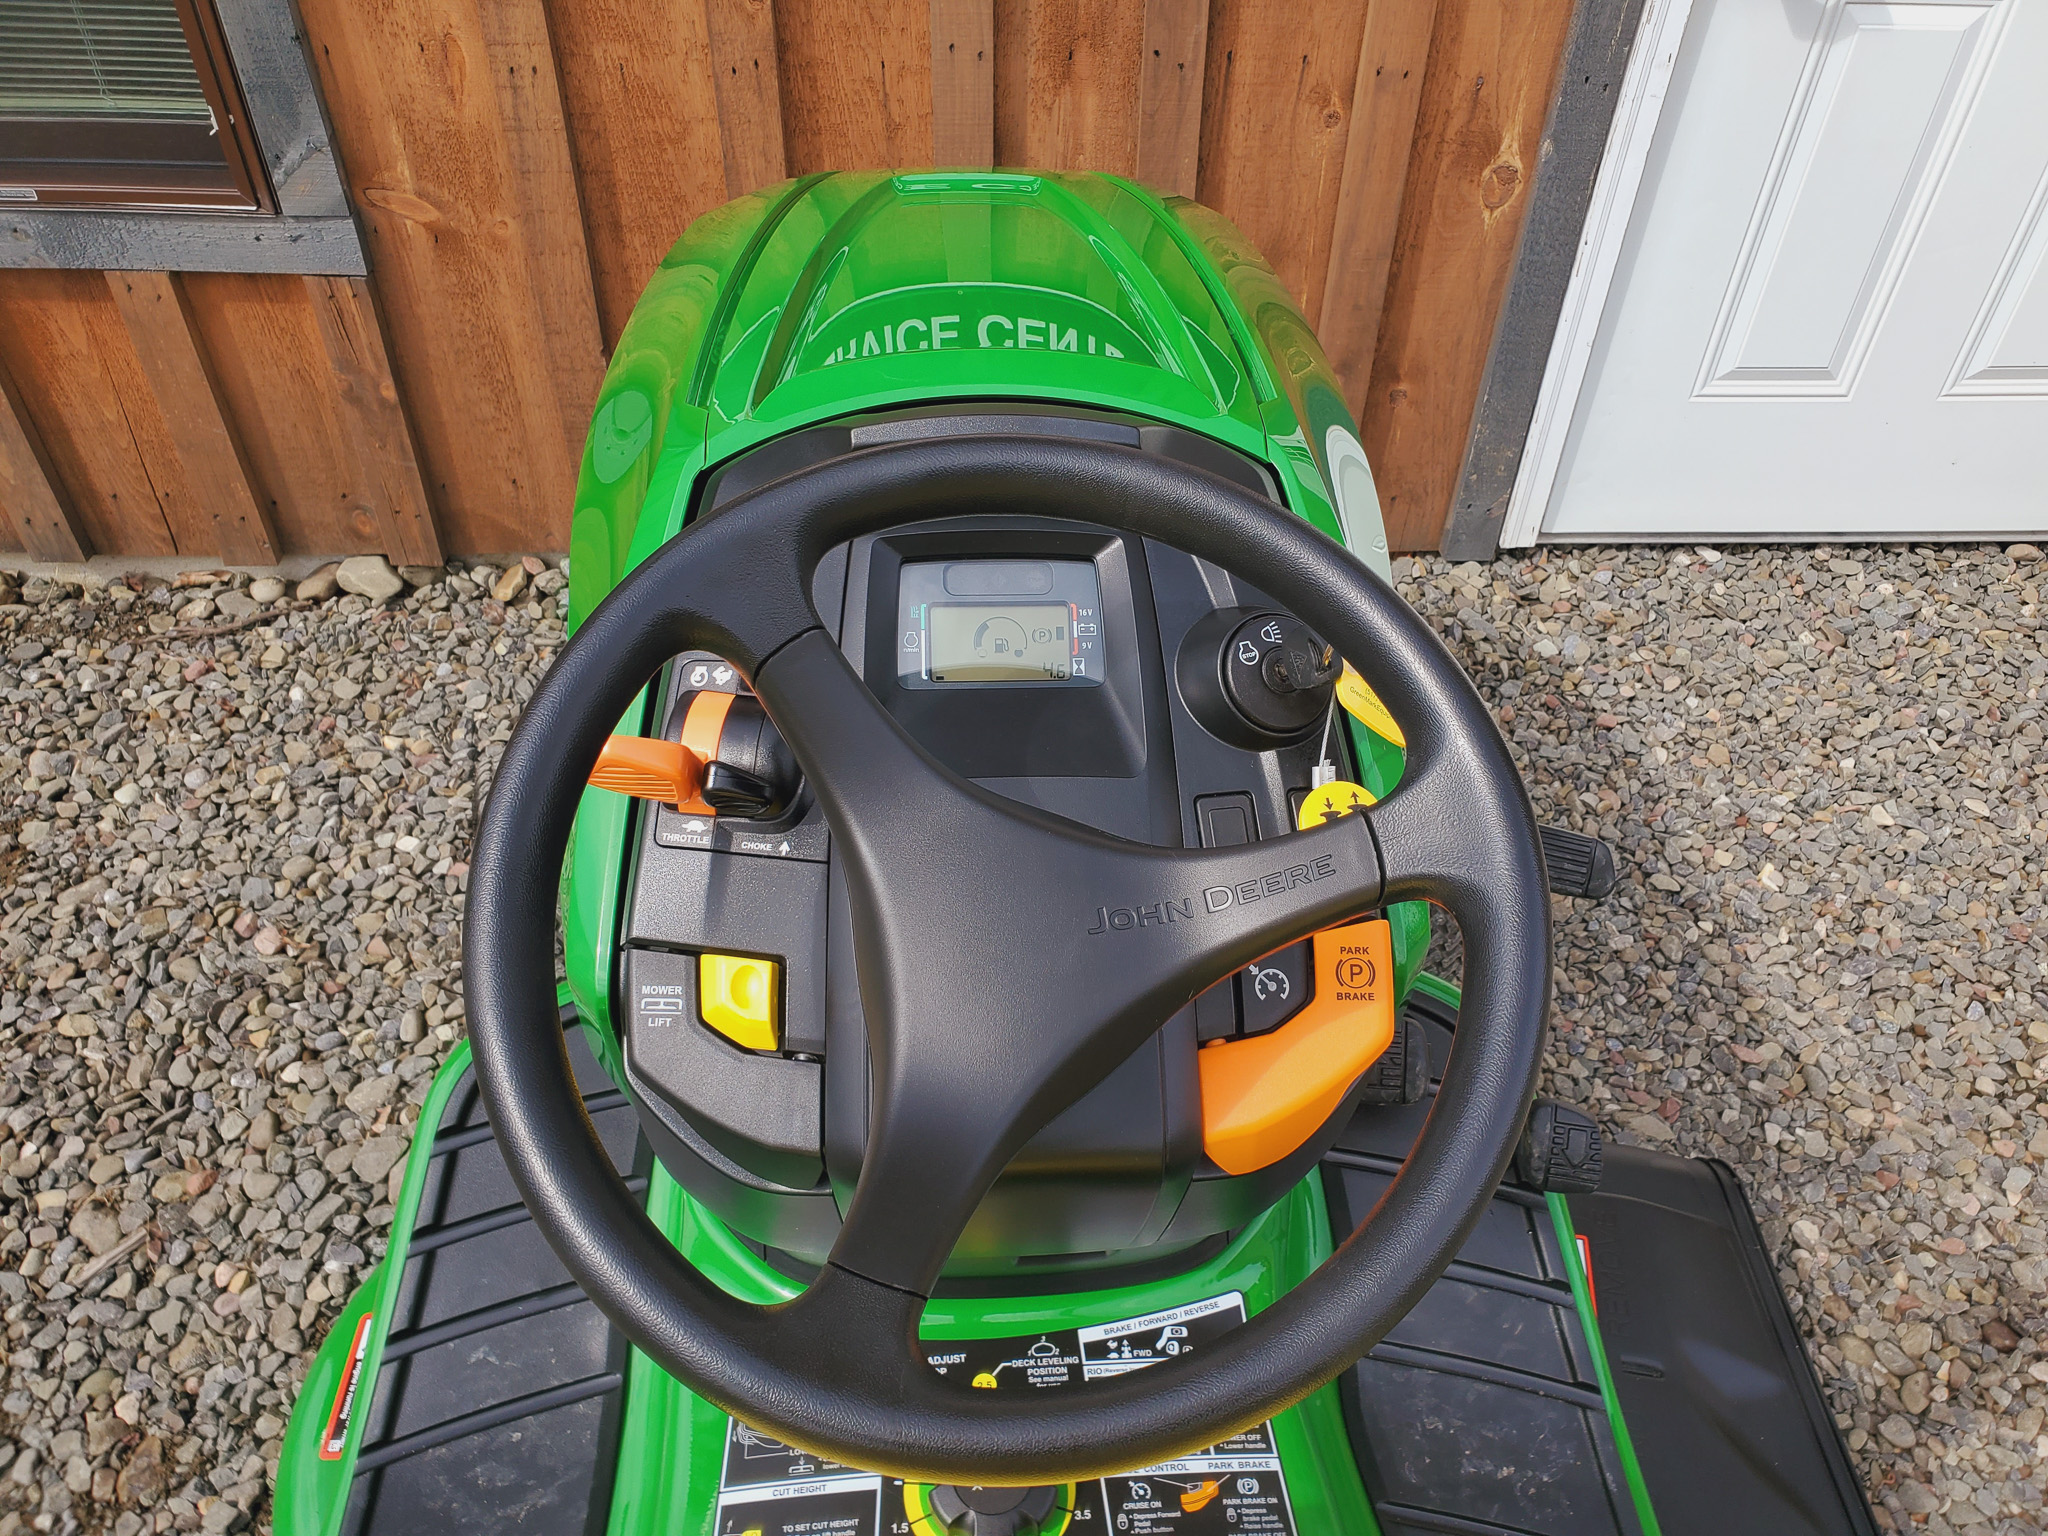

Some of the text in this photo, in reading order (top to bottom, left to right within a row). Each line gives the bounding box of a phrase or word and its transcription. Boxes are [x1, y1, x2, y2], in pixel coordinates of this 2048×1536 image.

[1242, 651, 1257, 660] STOP
[662, 832, 710, 844] THROTTLE
[741, 841, 773, 851] CHOKE
[1088, 854, 1336, 935] JOHN DEERE
[1340, 946, 1370, 955] PARK
[641, 986, 682, 995] MOWER
[1336, 992, 1375, 1001] BRAKE
[648, 1018, 672, 1027] LIFT
[1104, 1323, 1132, 1336] BRAKE
[1138, 1312, 1178, 1328] FORWARD
[1184, 1301, 1220, 1317] REVERSE
[1012, 1356, 1080, 1368] DECK LEVELING
[1027, 1366, 1068, 1376] POSITION
[1043, 1374, 1069, 1382] manual
[1208, 1461, 1234, 1470] PARK
[1238, 1460, 1271, 1469] BRAKE
[772, 1484, 827, 1497] CUT HEIGHT
[1123, 1502, 1148, 1510] CRUISE
[1074, 1510, 1092, 1520] 3.5
[782, 1518, 860, 1533] TO SET CUT HEIGHT
[890, 1522, 909, 1534] 1.5
